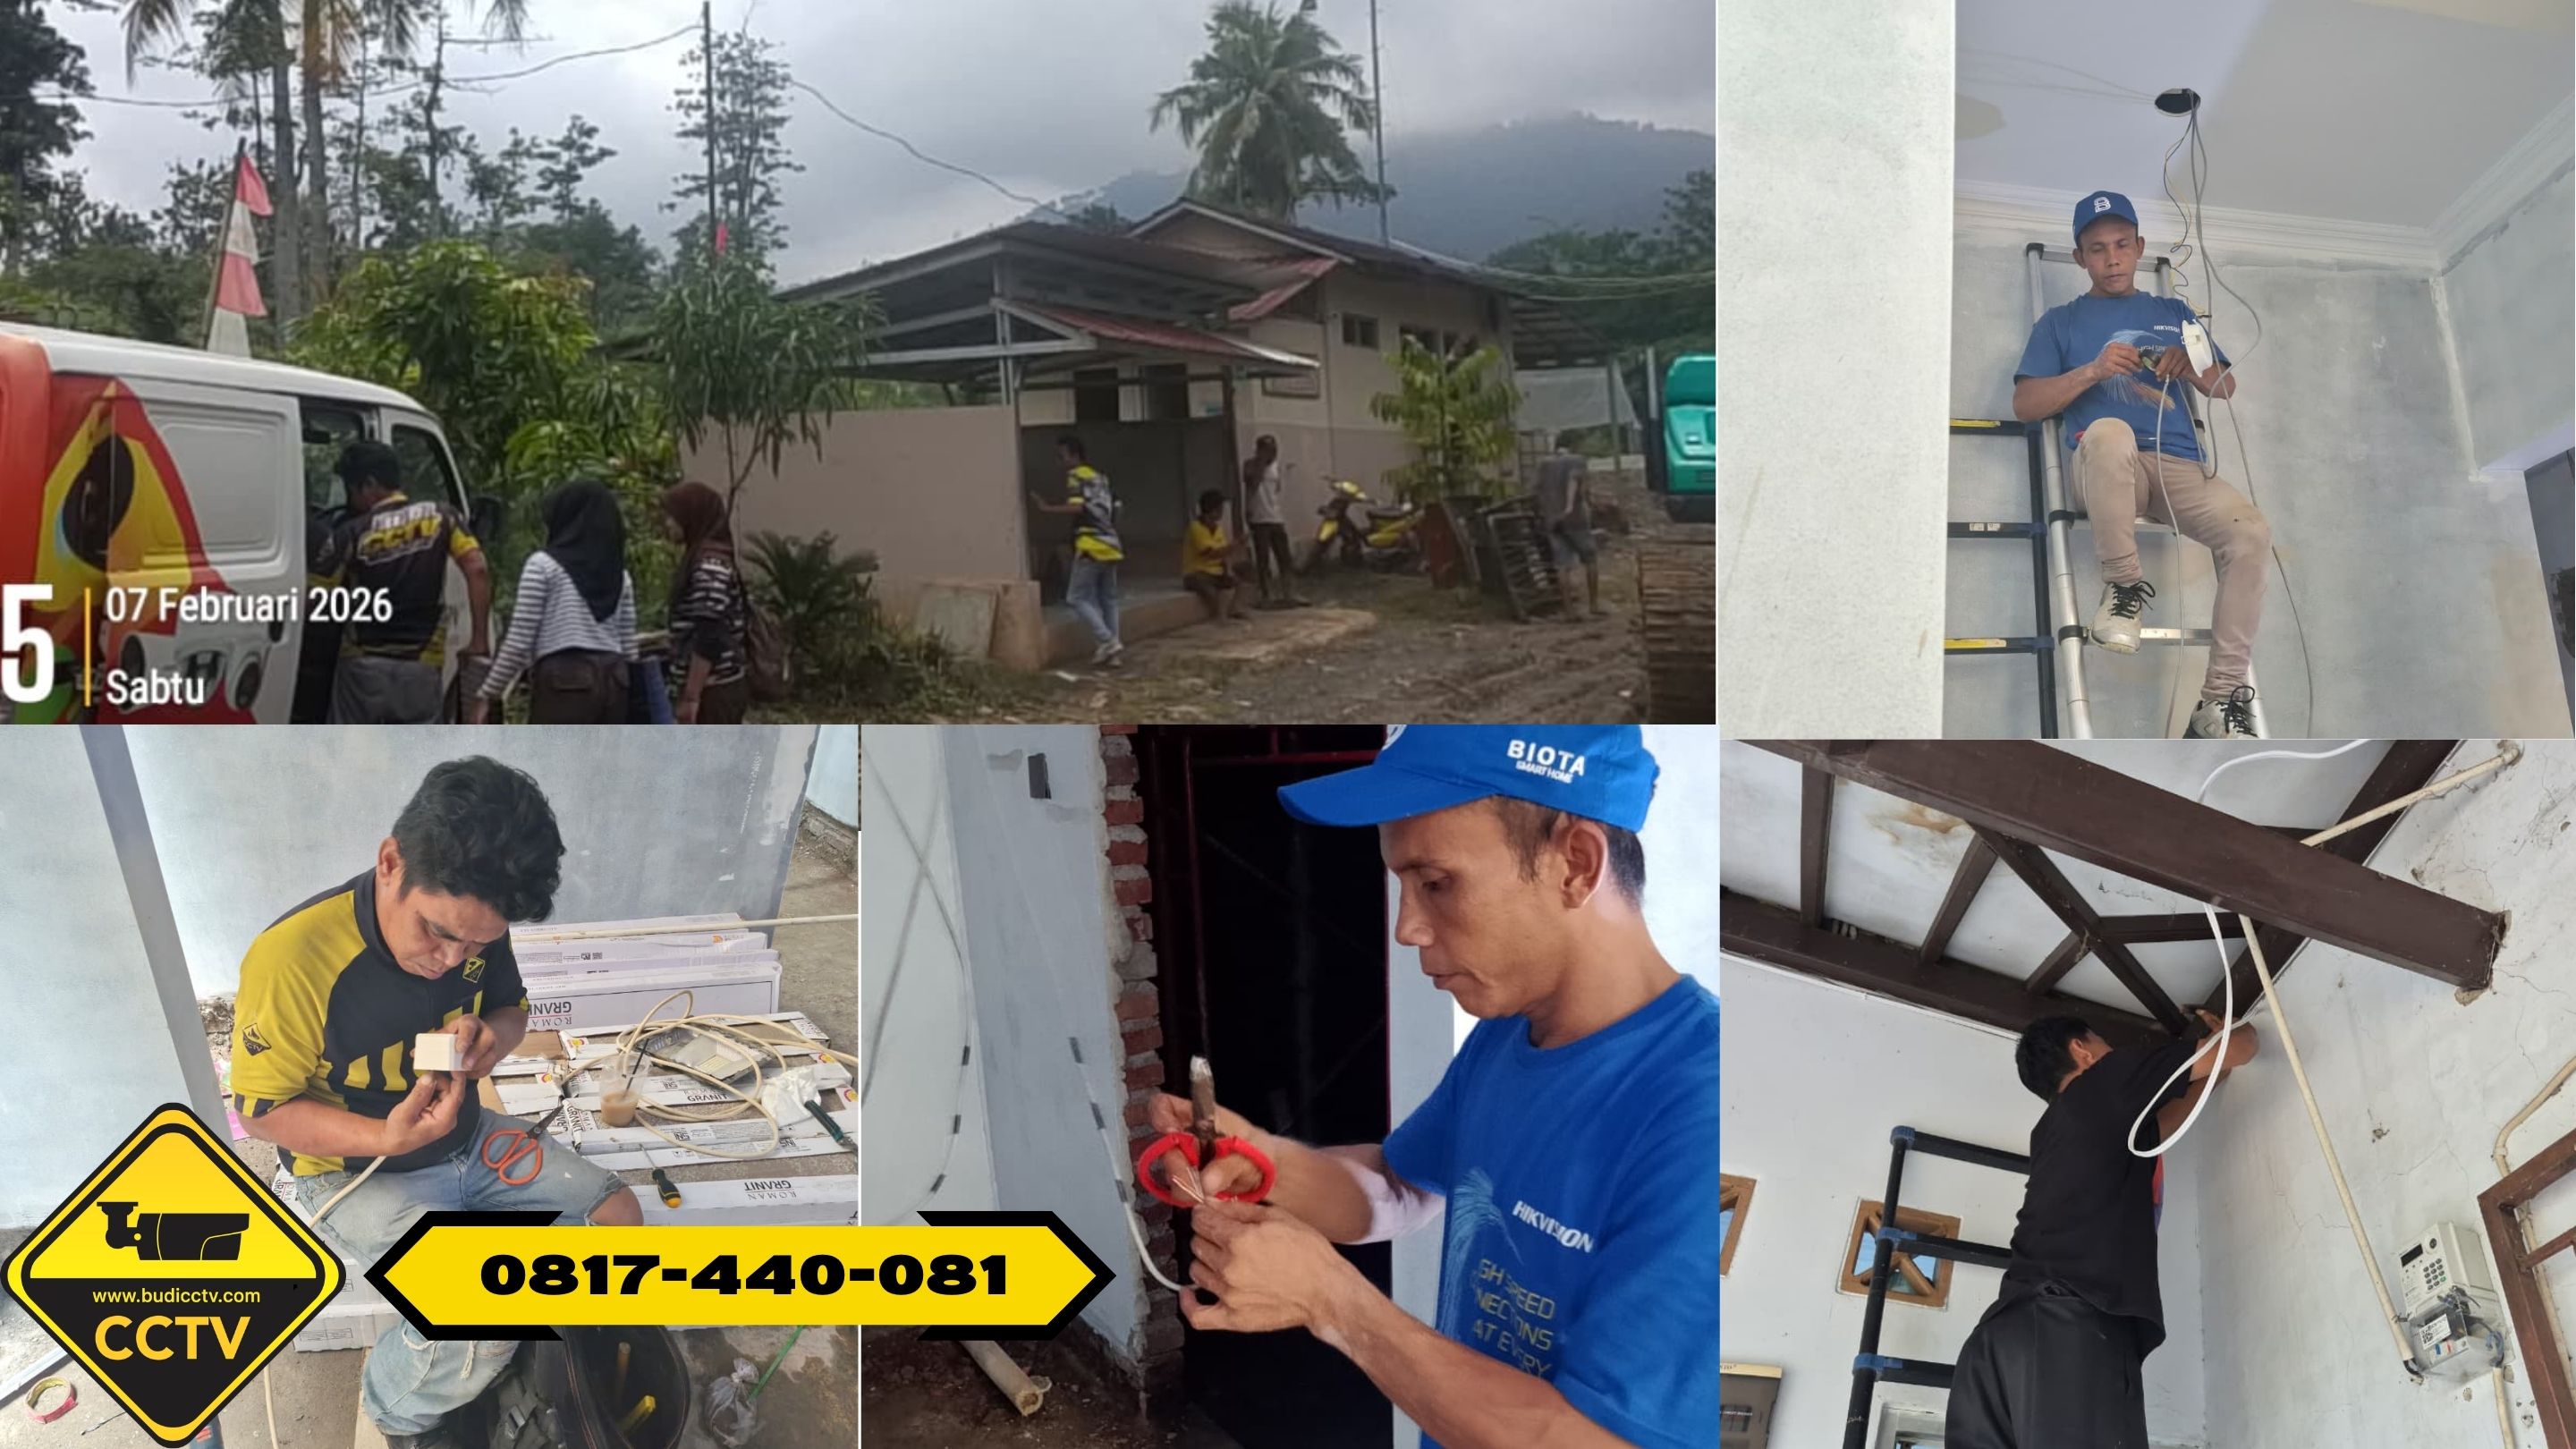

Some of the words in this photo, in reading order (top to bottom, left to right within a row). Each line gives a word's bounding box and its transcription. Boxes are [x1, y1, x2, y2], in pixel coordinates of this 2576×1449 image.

[1507, 739, 1585, 776] BIOTA
[687, 1093, 729, 1102] GRANIT
[744, 1180, 792, 1191] GRANIT
[748, 1191, 797, 1201] ROMAN
